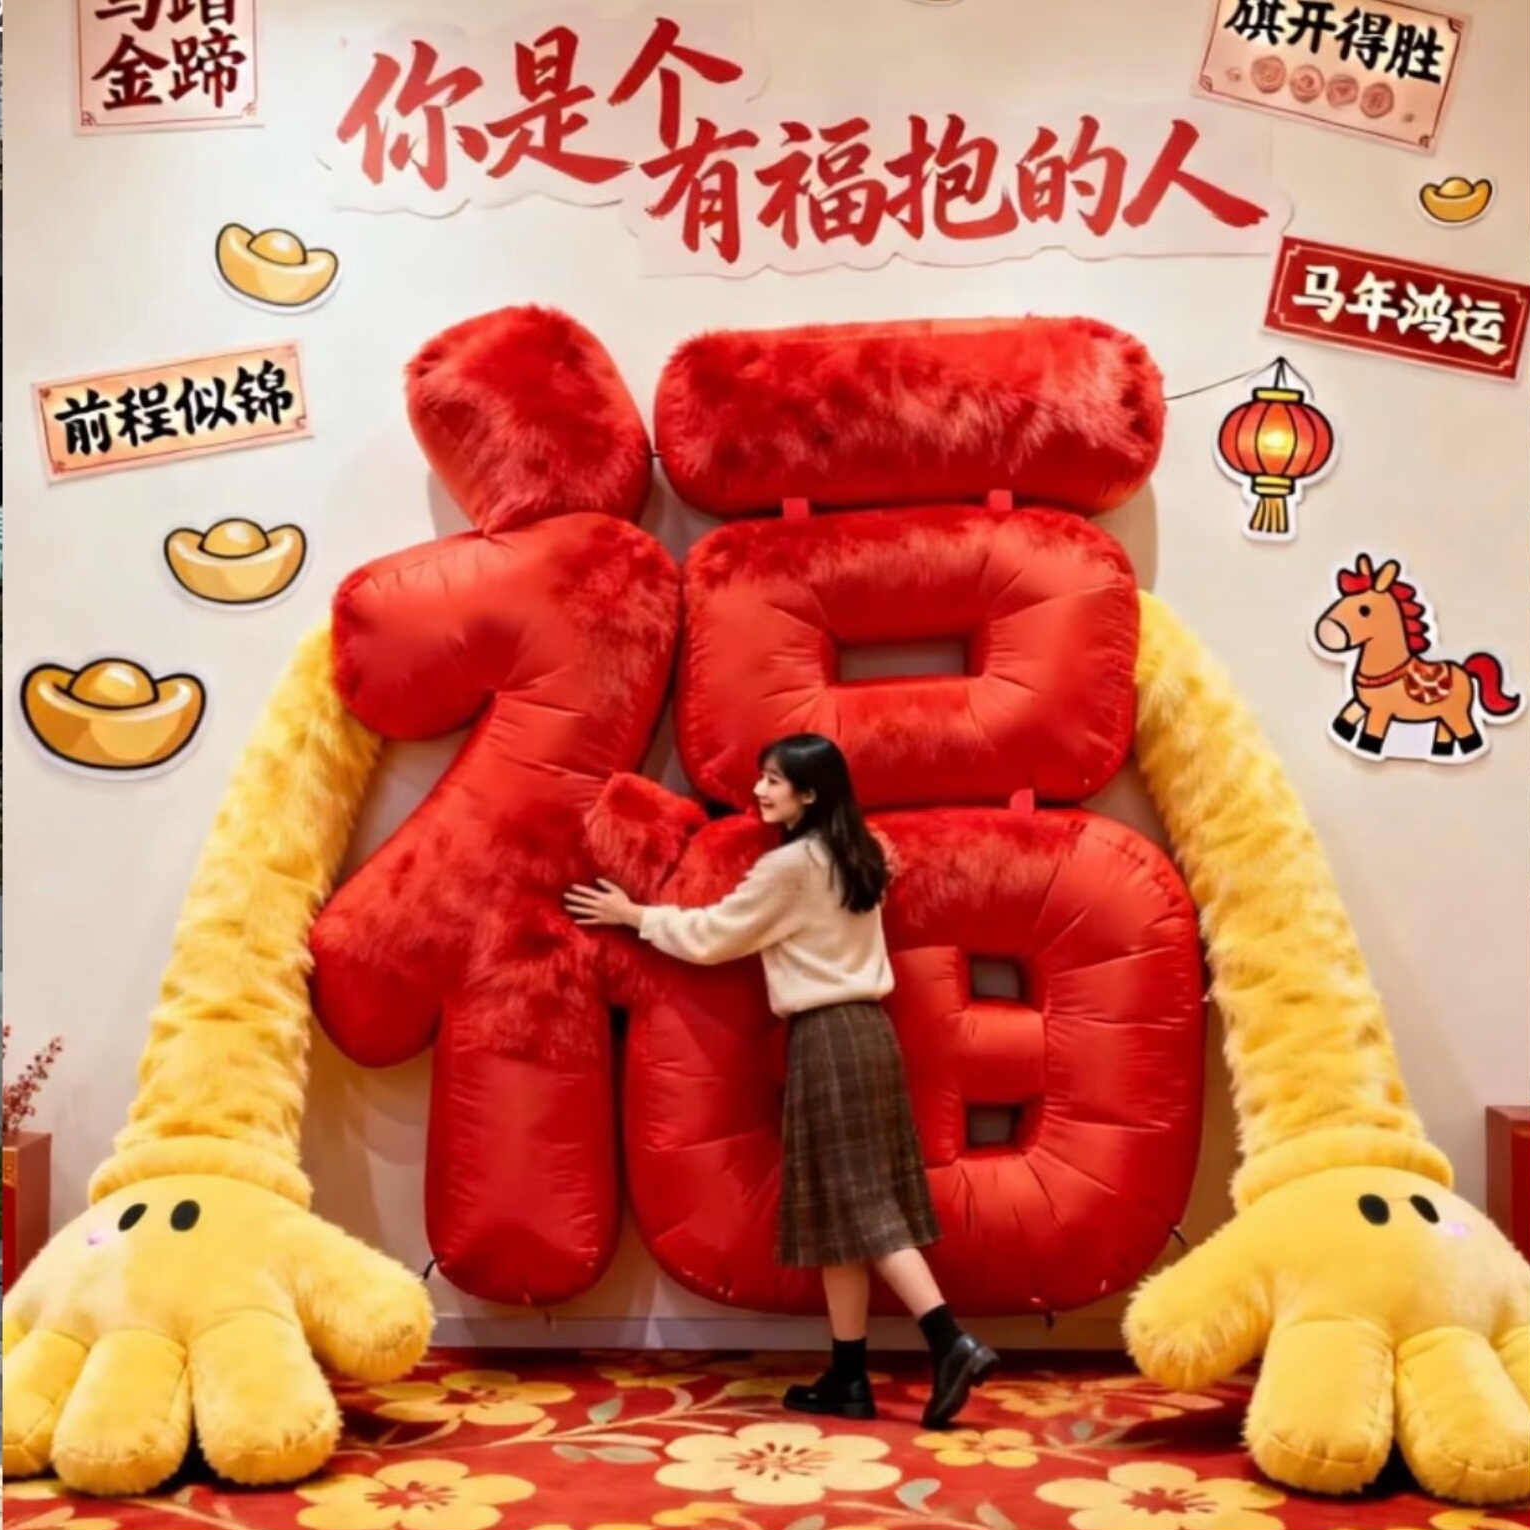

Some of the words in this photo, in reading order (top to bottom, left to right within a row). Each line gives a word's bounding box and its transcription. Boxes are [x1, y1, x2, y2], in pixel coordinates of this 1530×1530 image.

[91, 28, 248, 110] 金蹄
[1224, 0, 1445, 85] 旗开得胜
[336, 17, 743, 191] 你是个
[639, 112, 1270, 264] 有福抱的人
[1291, 263, 1508, 356] 马年鸿运
[53, 358, 295, 456] 前程似锦
